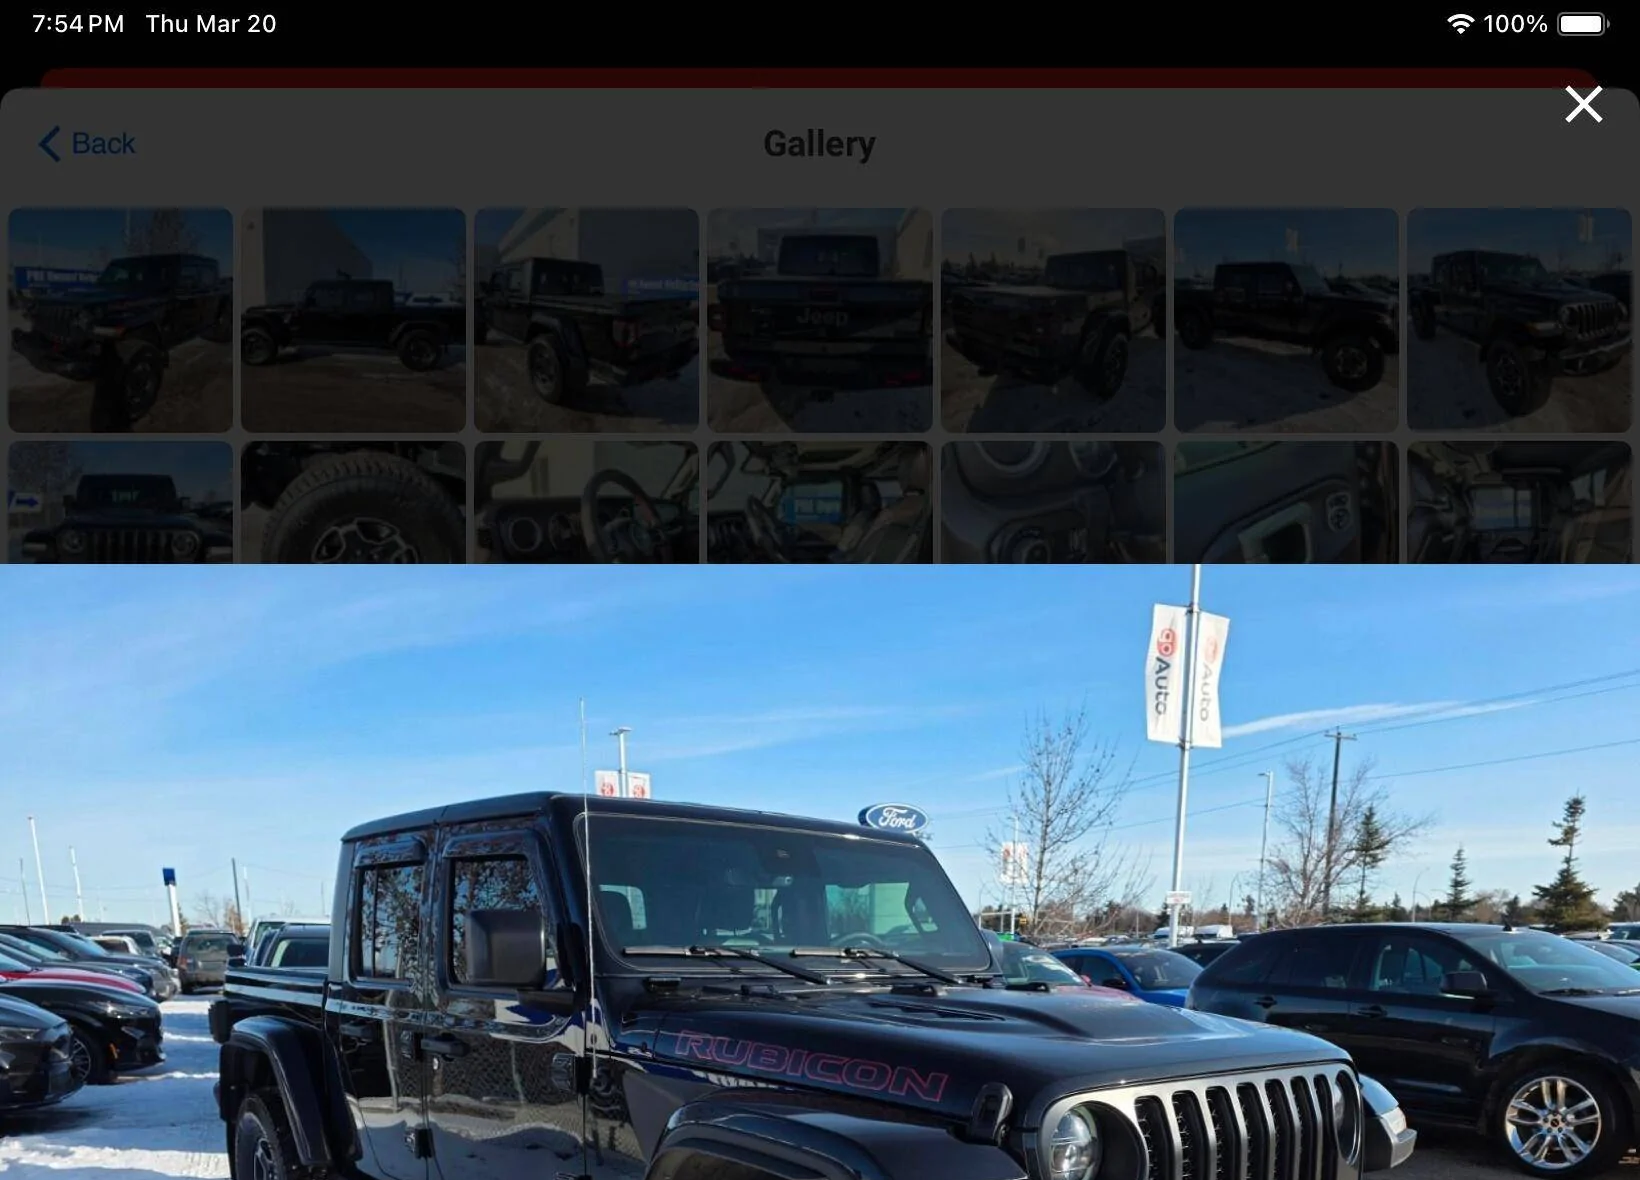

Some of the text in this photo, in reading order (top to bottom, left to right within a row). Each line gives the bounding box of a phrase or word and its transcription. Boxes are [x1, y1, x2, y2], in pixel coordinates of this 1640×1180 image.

[32, 14, 124, 33] 7:54 PM
[145, 13, 277, 33] Thu Mar 20
[1483, 14, 1548, 33] 100%
[71, 130, 137, 156] Back
[763, 128, 876, 164] Gallery
[878, 806, 917, 829] Ford
[674, 1029, 950, 1102] RUBICON
